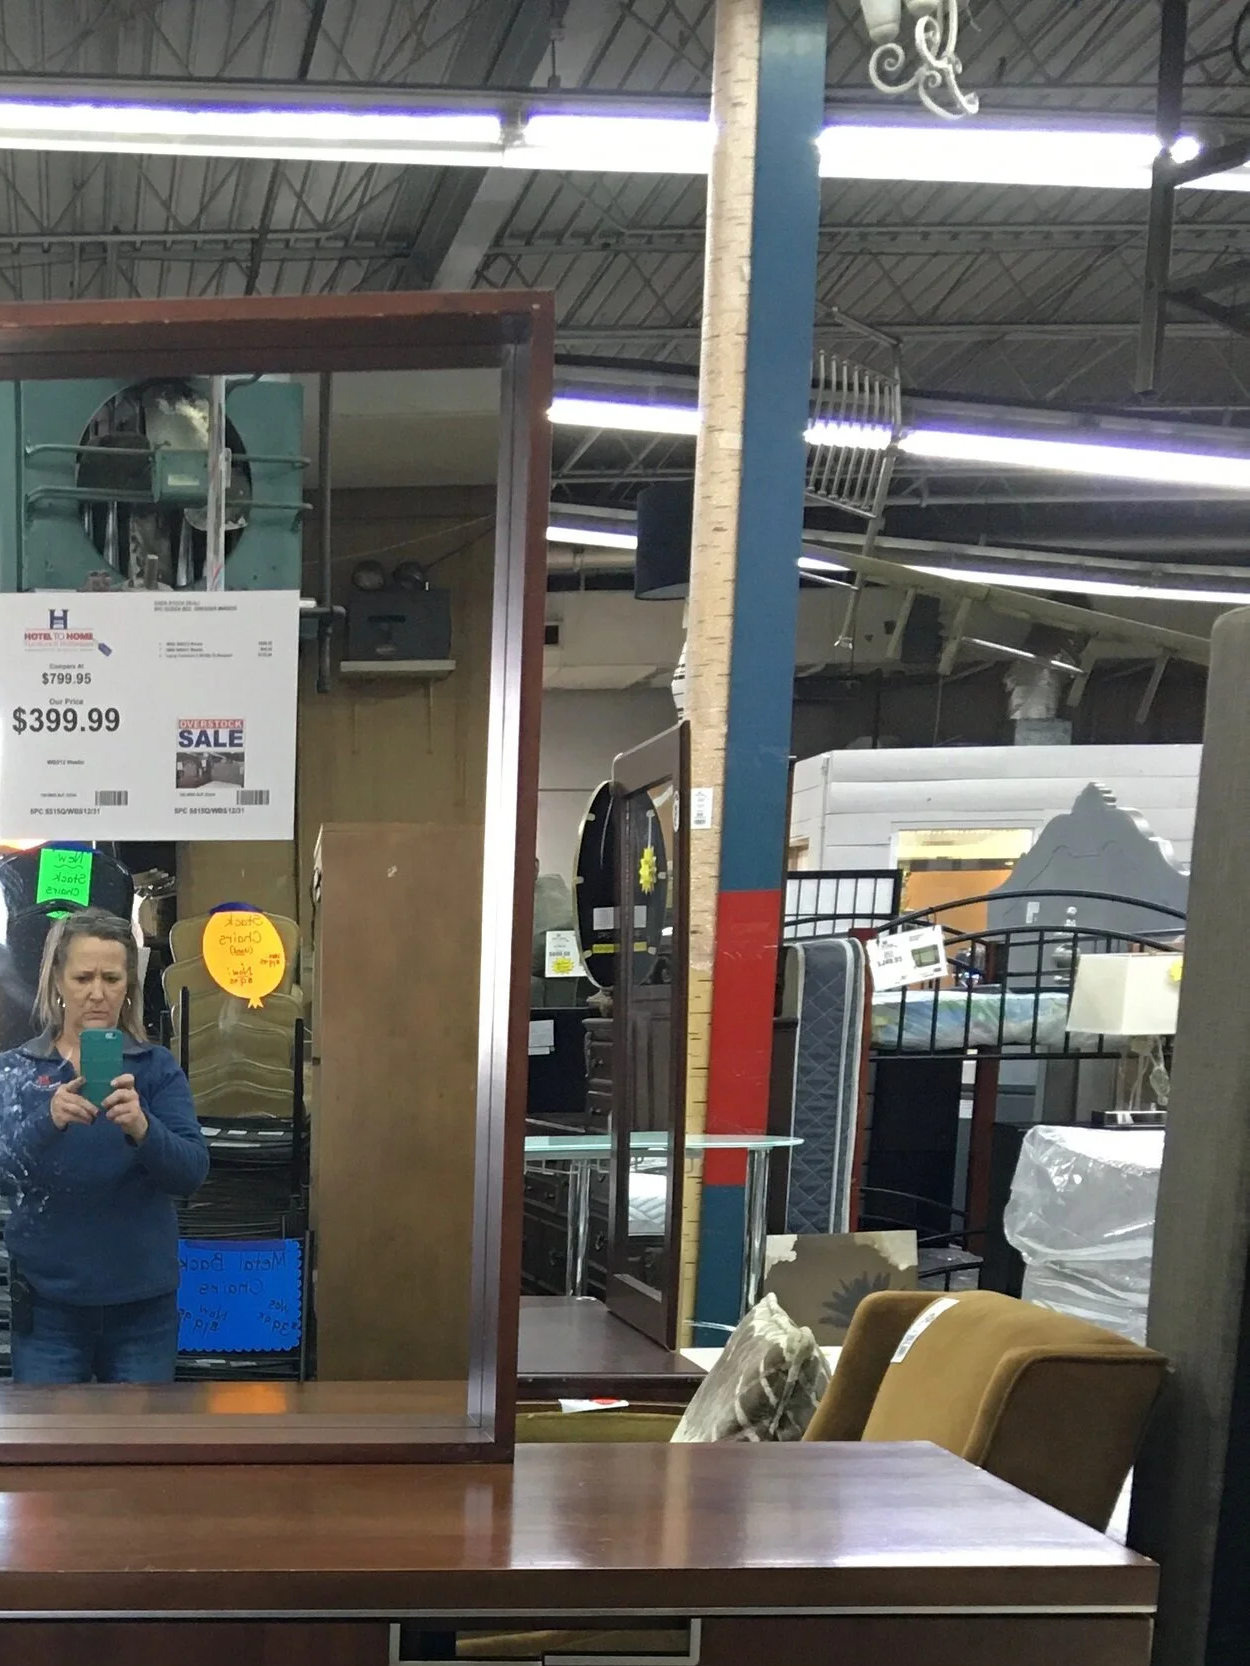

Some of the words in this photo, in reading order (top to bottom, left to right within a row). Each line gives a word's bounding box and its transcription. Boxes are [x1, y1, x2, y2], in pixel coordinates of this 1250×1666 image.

[42, 672, 92, 685] $799.95
[12, 706, 120, 735] $399.99
[179, 719, 243, 728] OVERSTOCK
[178, 730, 244, 747] SALE
